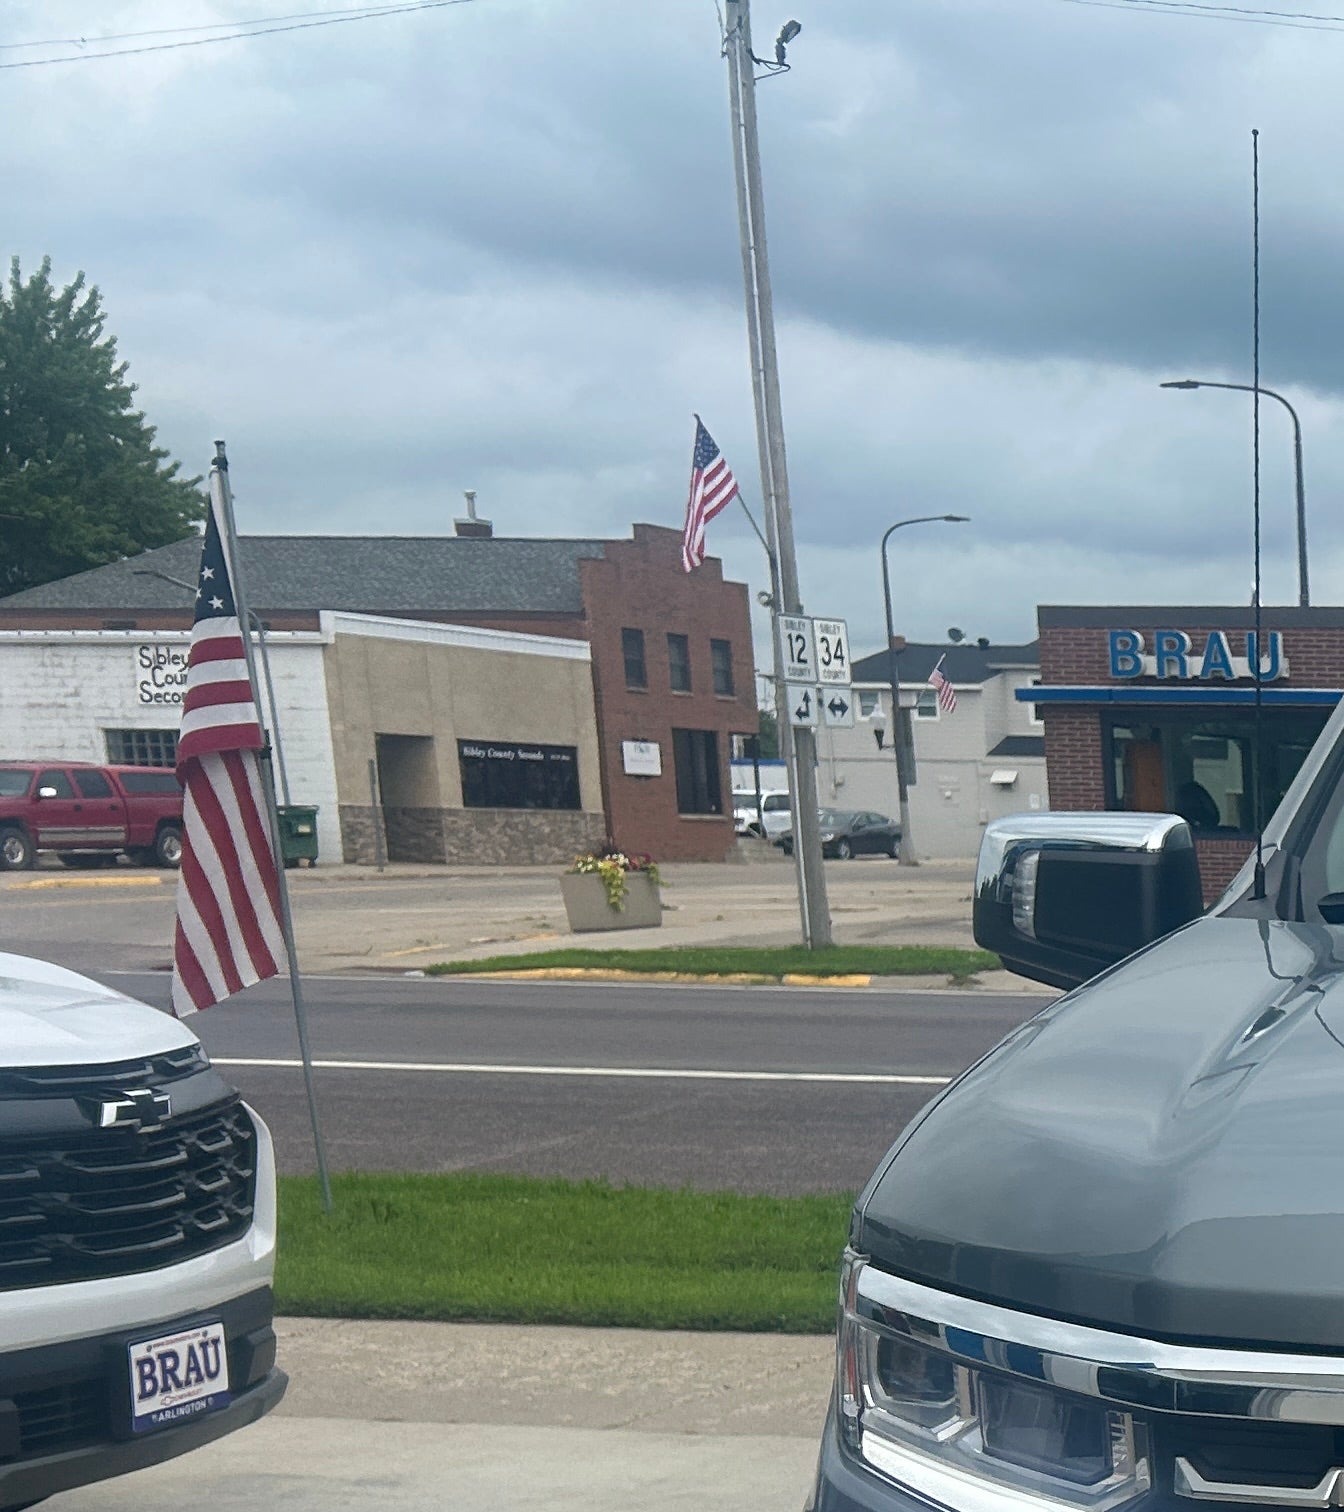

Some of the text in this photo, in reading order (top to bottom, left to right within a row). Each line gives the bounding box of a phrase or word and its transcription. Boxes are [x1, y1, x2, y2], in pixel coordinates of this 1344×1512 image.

[787, 632, 808, 664] 12
[820, 636, 845, 667] 34
[1108, 629, 1284, 683] BRAU
[135, 1335, 221, 1402] BRAU
